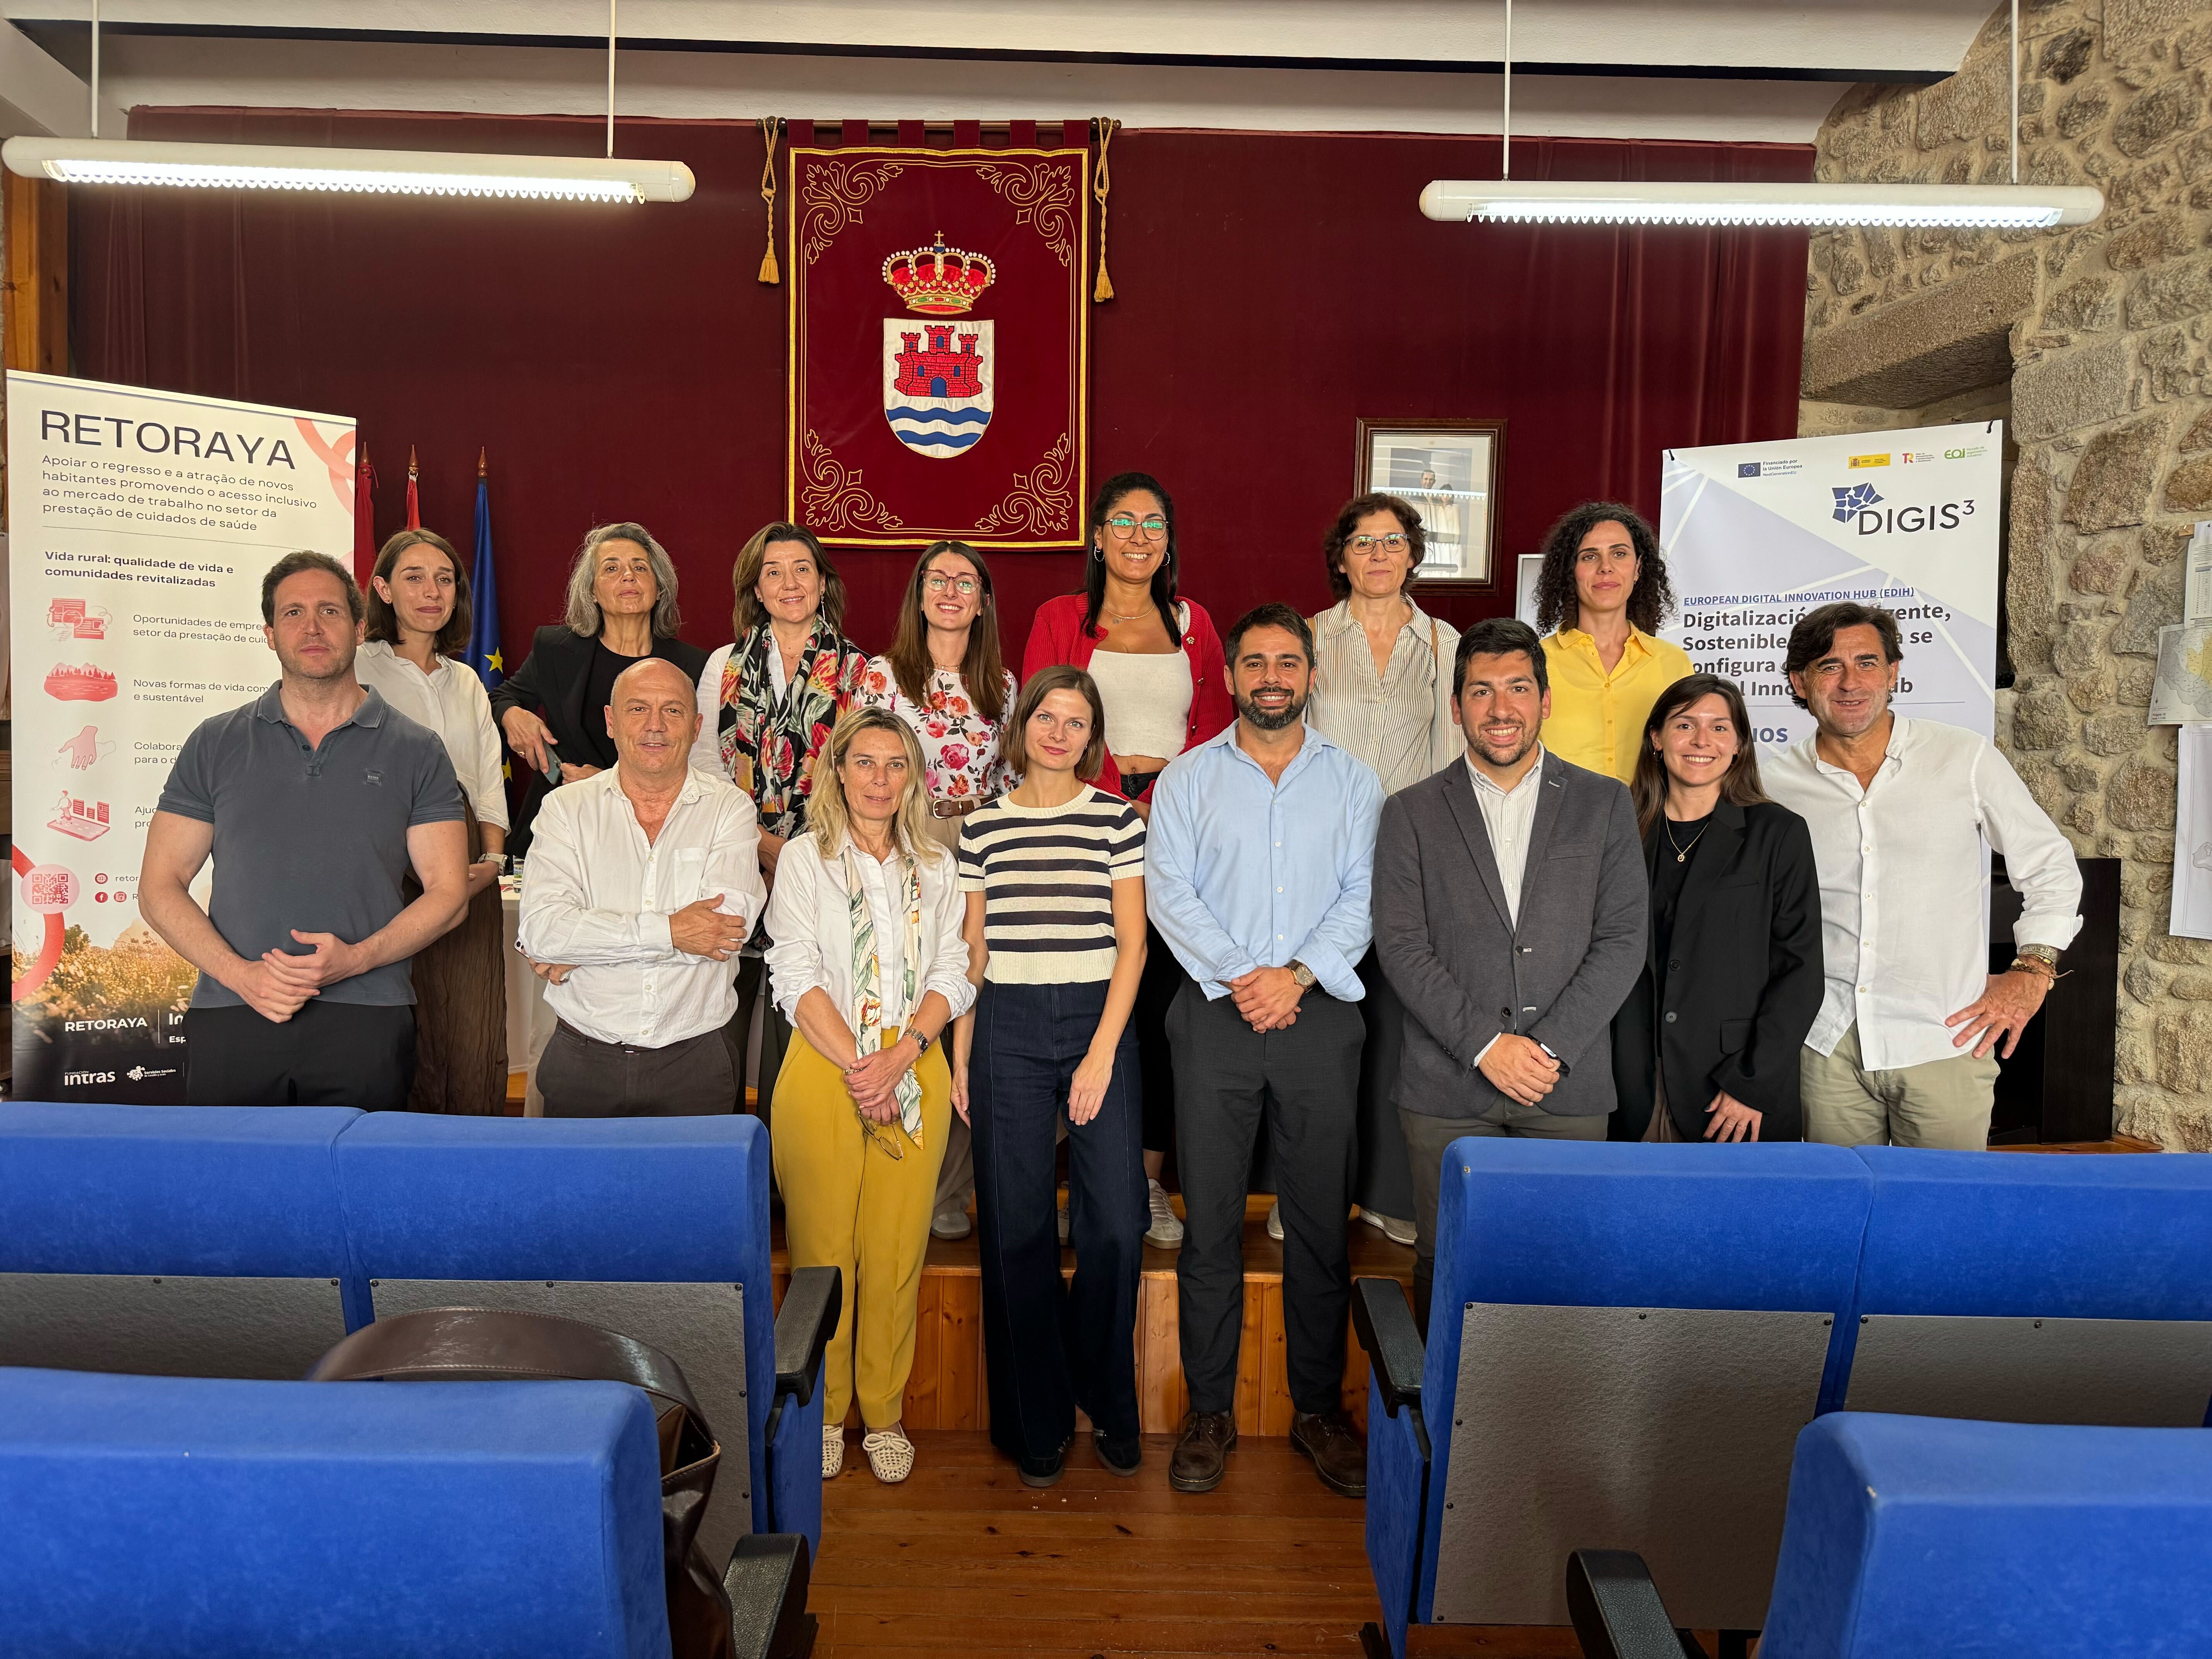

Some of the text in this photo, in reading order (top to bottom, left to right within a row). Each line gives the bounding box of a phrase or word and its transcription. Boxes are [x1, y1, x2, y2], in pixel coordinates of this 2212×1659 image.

[42, 410, 295, 469] RETORAYA
[42, 455, 87, 467] Apoiar
[103, 463, 161, 475] regresso
[187, 472, 235, 484] atração
[239, 477, 254, 486] de
[259, 481, 293, 491] novos
[43, 471, 116, 485] habitantes
[121, 480, 203, 495] promovendo
[219, 491, 261, 501] acesso
[266, 494, 316, 508] inclusivo
[64, 491, 124, 501] mercado
[128, 495, 144, 504] de
[148, 497, 203, 510] trabalho
[226, 507, 258, 515] setor
[262, 508, 276, 517] da
[43, 505, 257, 530] prestação de cuidados de saúde
[45, 551, 74, 560] Vida
[78, 555, 110, 563] rural:
[114, 558, 175, 568] qualidade
[179, 562, 194, 570] de
[198, 564, 223, 572] vida
[45, 569, 215, 587] comunidades revitalizadas
[1684, 587, 1914, 605] EUROPEAN DIGITAL INNOVATION HUB (EDIH)
[134, 615, 211, 627] Oportunidades
[230, 620, 264, 631] empre
[180, 632, 231, 641] prestação
[1910, 632, 1932, 644] se
[1693, 658, 1775, 677] onfigura
[134, 680, 167, 688] Novas
[170, 681, 206, 689] formas
[65, 1017, 148, 1032] RETORAYA
